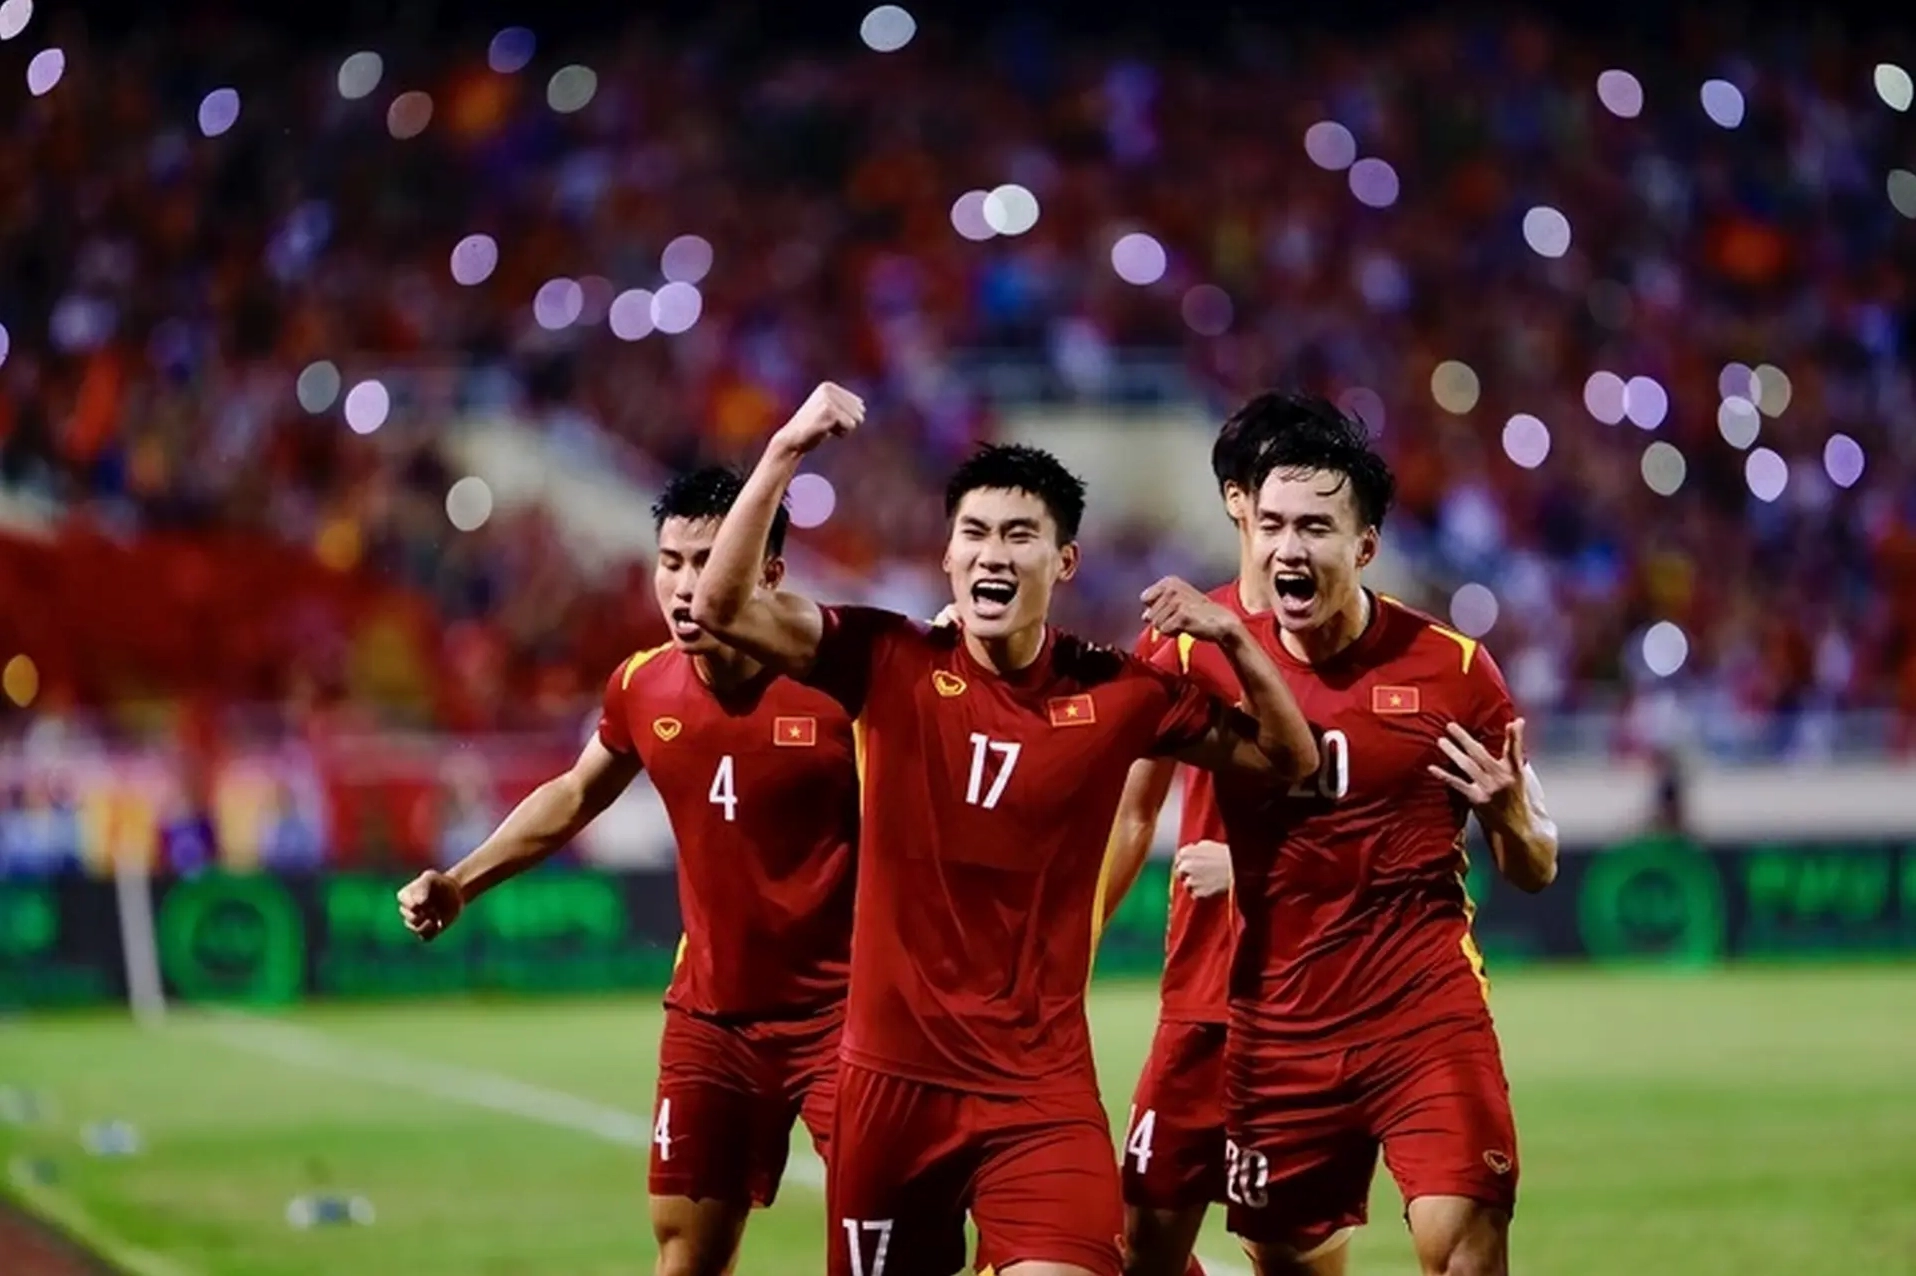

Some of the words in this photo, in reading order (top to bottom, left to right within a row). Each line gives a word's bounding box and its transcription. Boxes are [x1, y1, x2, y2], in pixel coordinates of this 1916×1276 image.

[709, 754, 738, 821] 4
[965, 731, 1022, 809] 17
[654, 1097, 672, 1161] 4
[842, 1218, 894, 1276] 17
